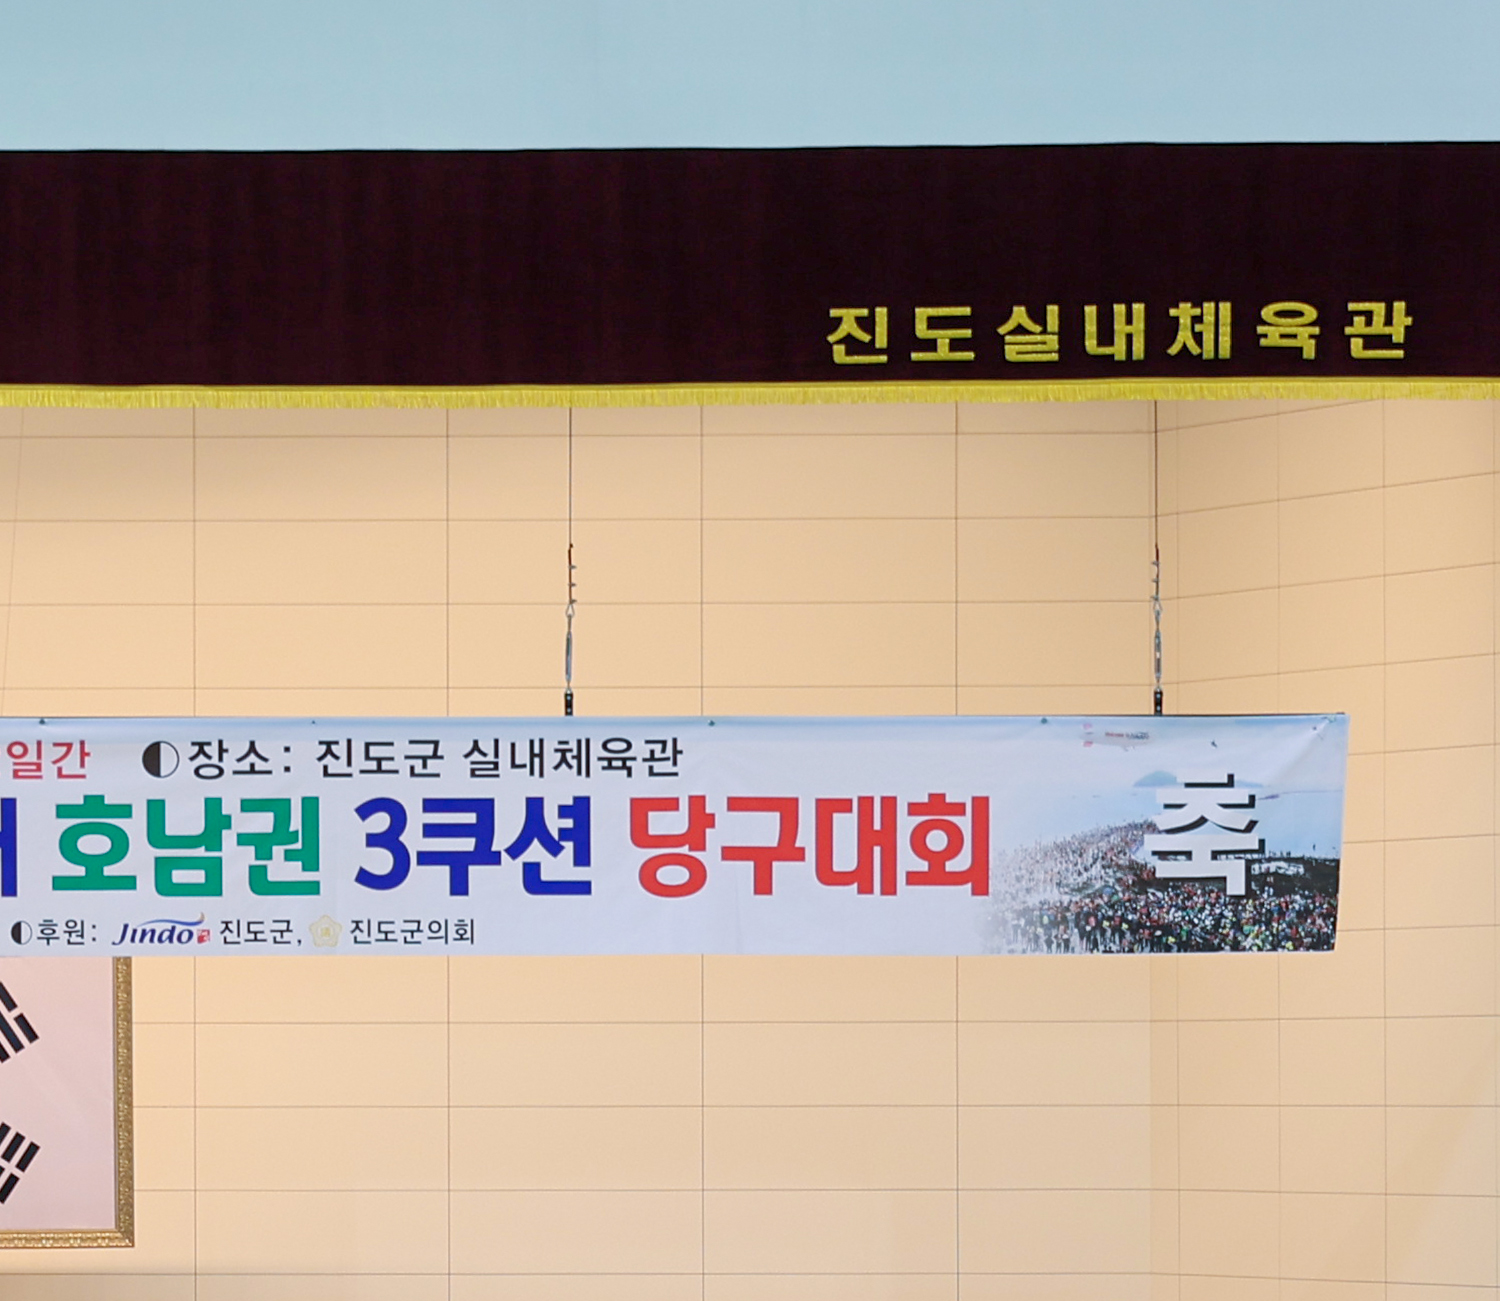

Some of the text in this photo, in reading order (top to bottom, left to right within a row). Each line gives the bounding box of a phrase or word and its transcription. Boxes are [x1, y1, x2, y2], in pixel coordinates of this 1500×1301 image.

[826, 301, 1413, 364] 진도실내체육관
[187, 738, 683, 779] 장소: 진도군 실내체육관
[50, 794, 321, 898] 호남권
[353, 795, 593, 898] 3쿠션
[628, 793, 991, 899] 당구대회
[1143, 771, 1262, 897] 축
[37, 916, 476, 947] 후원: Jindo 진도군, 진도군의회
